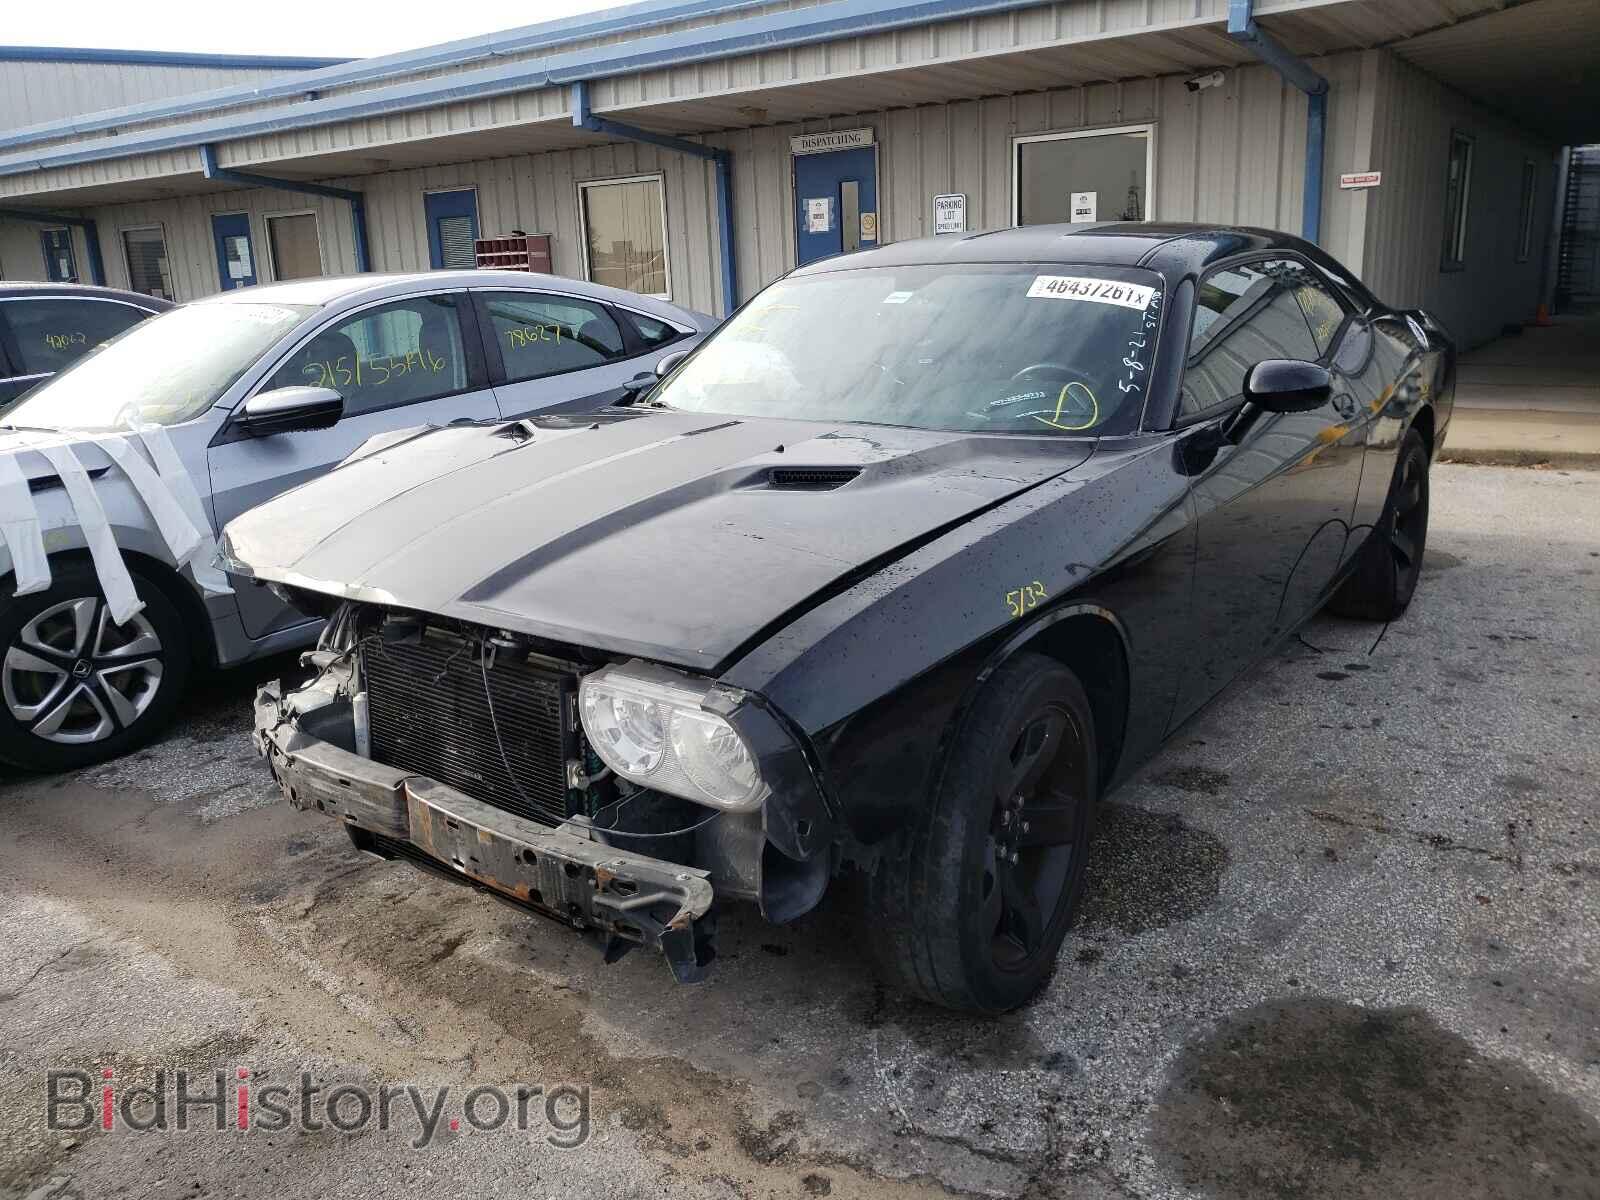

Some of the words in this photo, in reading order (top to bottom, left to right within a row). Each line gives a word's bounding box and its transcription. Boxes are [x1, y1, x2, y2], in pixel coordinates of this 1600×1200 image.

[802, 133, 861, 148] DISPATCHING
[937, 199, 962, 210] PARKING
[944, 210, 955, 220] LOT
[1006, 579, 1049, 617] 5/32
